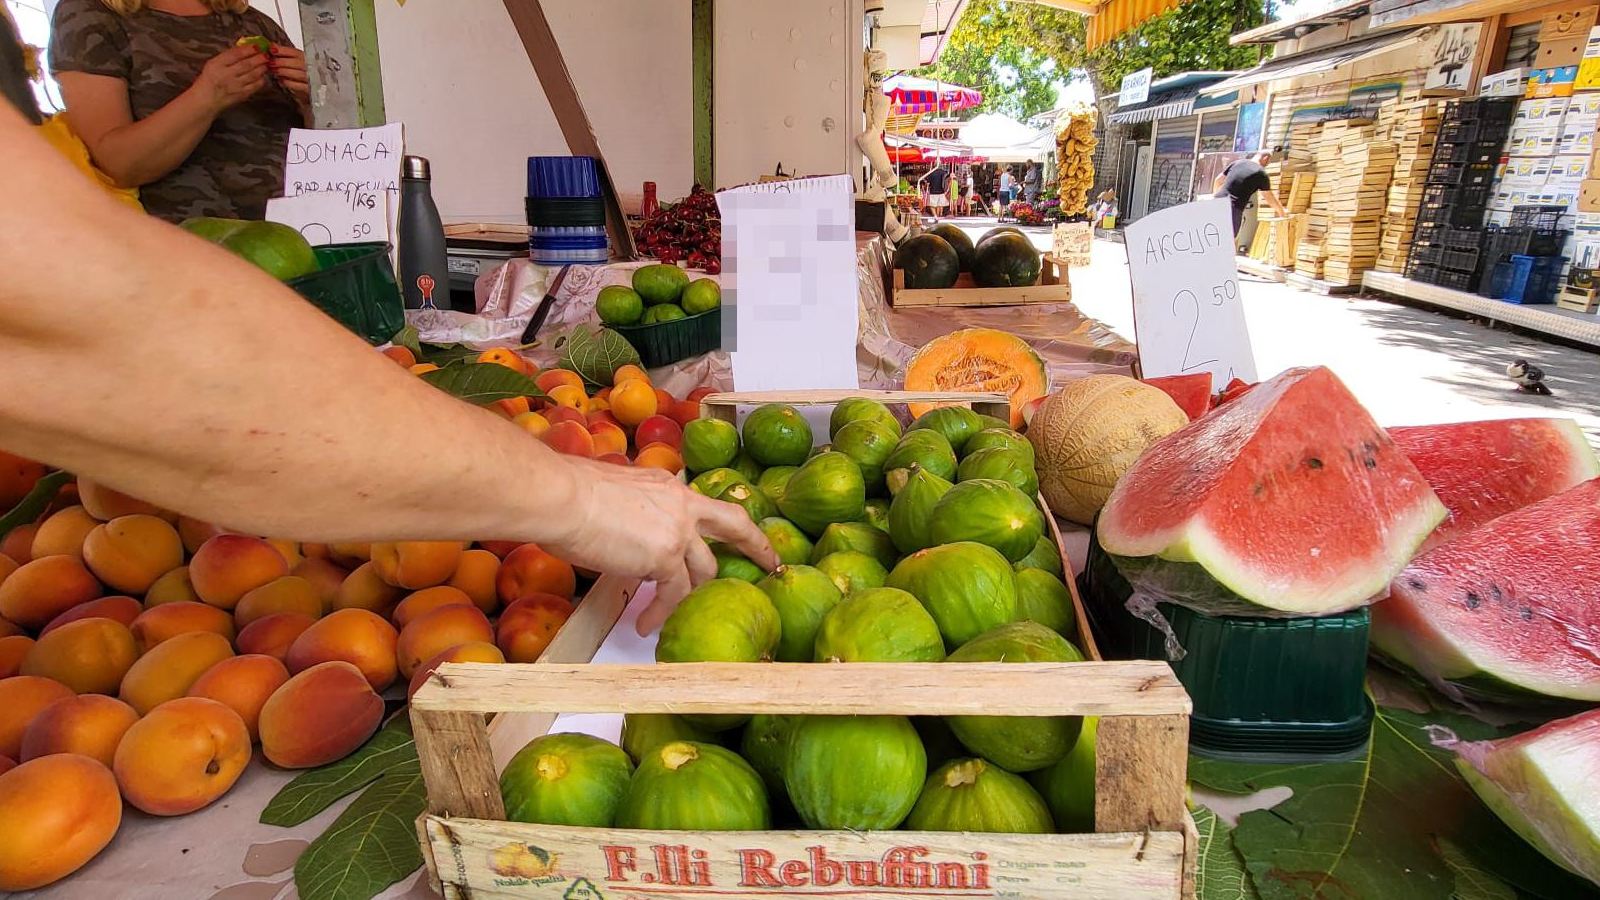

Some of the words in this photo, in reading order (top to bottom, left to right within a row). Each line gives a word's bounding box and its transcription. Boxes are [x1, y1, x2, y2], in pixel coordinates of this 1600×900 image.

[288, 132, 390, 164] DOMAĆA
[353, 223, 371, 238] 50
[1145, 222, 1221, 265] AKCIJA
[1172, 289, 1219, 372] 2
[1213, 279, 1237, 306] 50
[599, 844, 713, 886] F.lli
[737, 845, 992, 889] Rebuffini
